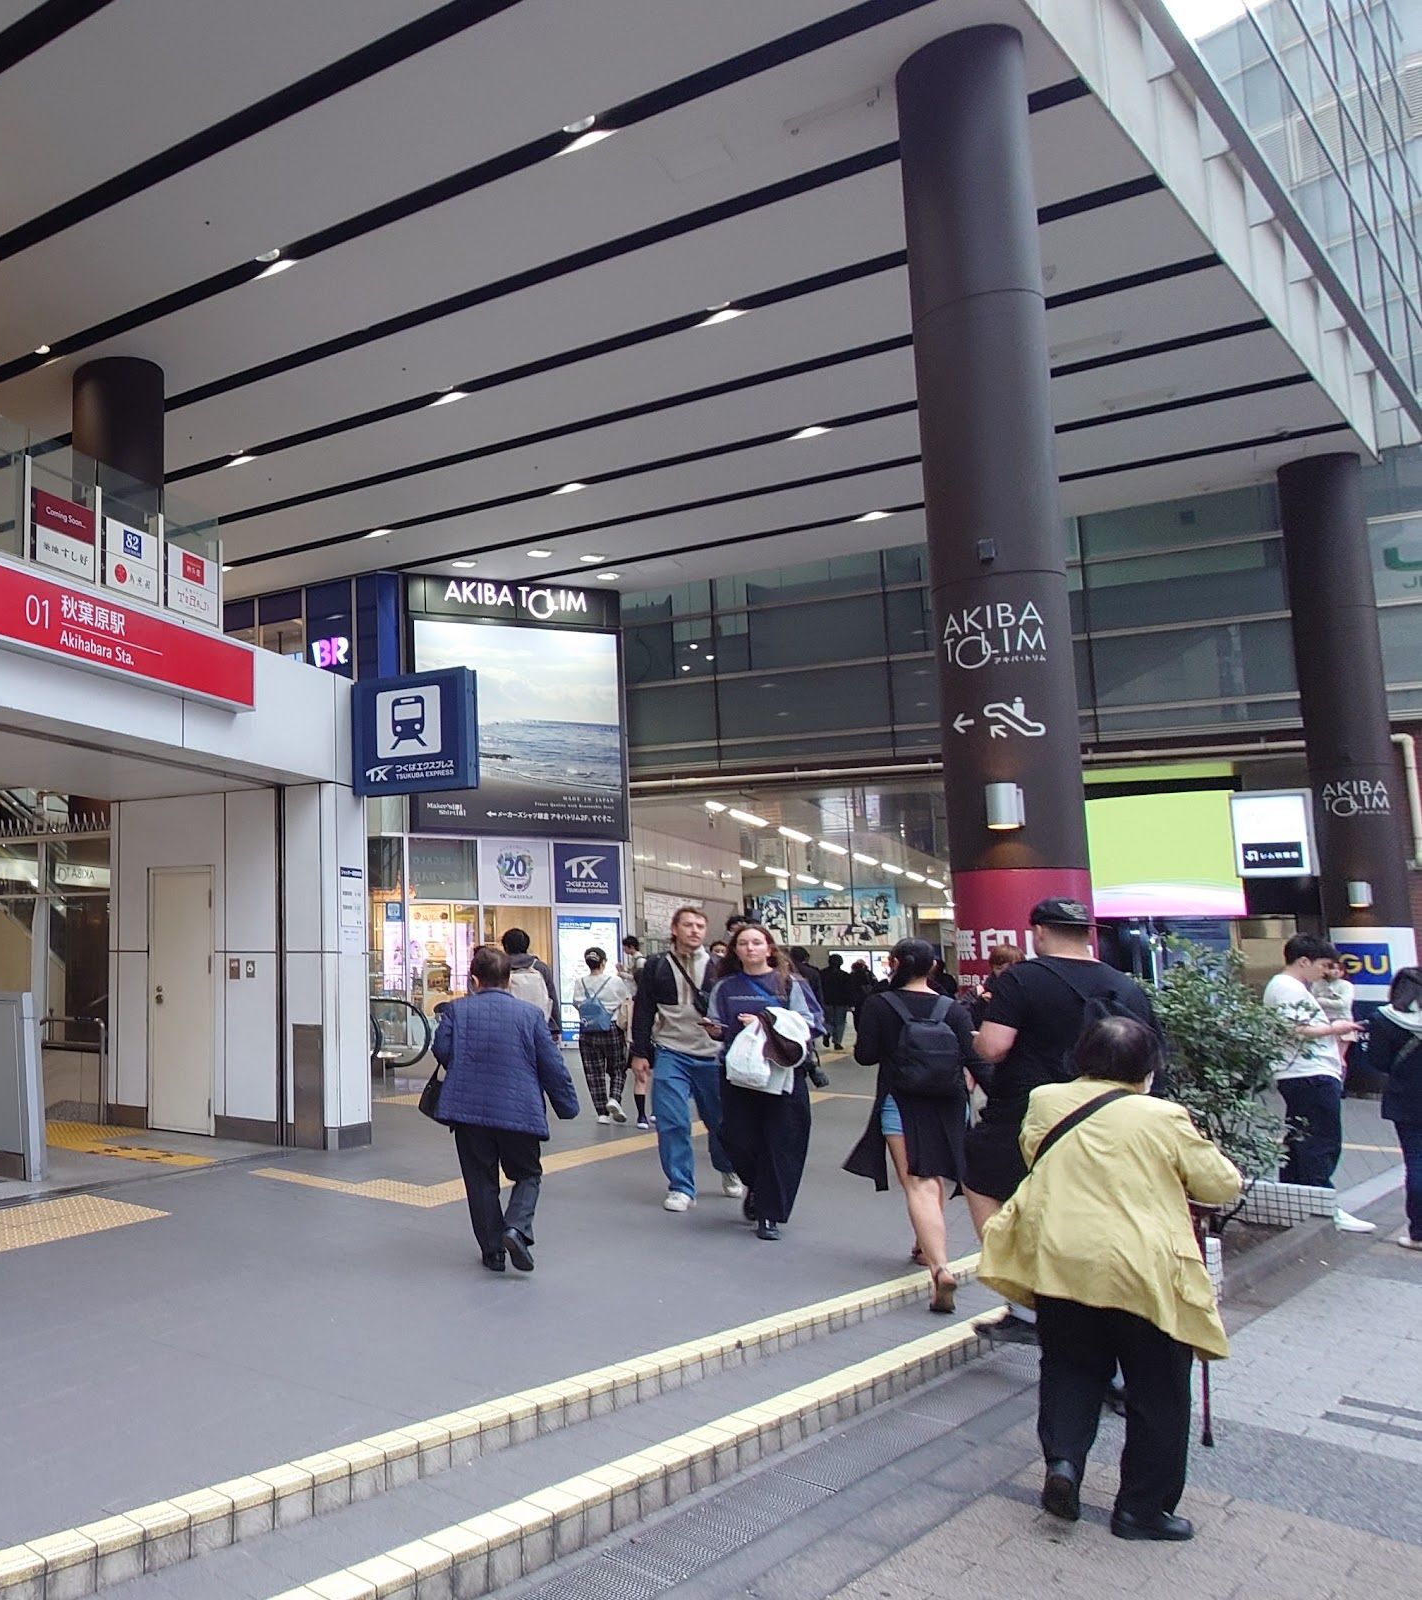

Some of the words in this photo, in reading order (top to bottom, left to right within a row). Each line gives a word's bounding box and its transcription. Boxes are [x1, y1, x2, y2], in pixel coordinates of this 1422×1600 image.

[45, 506, 68, 523] Coming
[126, 533, 139, 551] 82
[444, 580, 514, 607] AKIBA
[26, 595, 50, 630] 01
[60, 594, 125, 637] 秋葉原駅
[943, 601, 1044, 639] AKIBA
[60, 630, 112, 660] Akihabara
[115, 646, 135, 666] Sta.
[366, 765, 393, 782] TX
[395, 760, 454, 772] つくばエクスプレス
[425, 769, 454, 777] EXPRESS
[1322, 780, 1388, 797] AKIBA
[504, 856, 527, 877] 20
[565, 855, 607, 879] TX
[1338, 953, 1389, 975] GU
